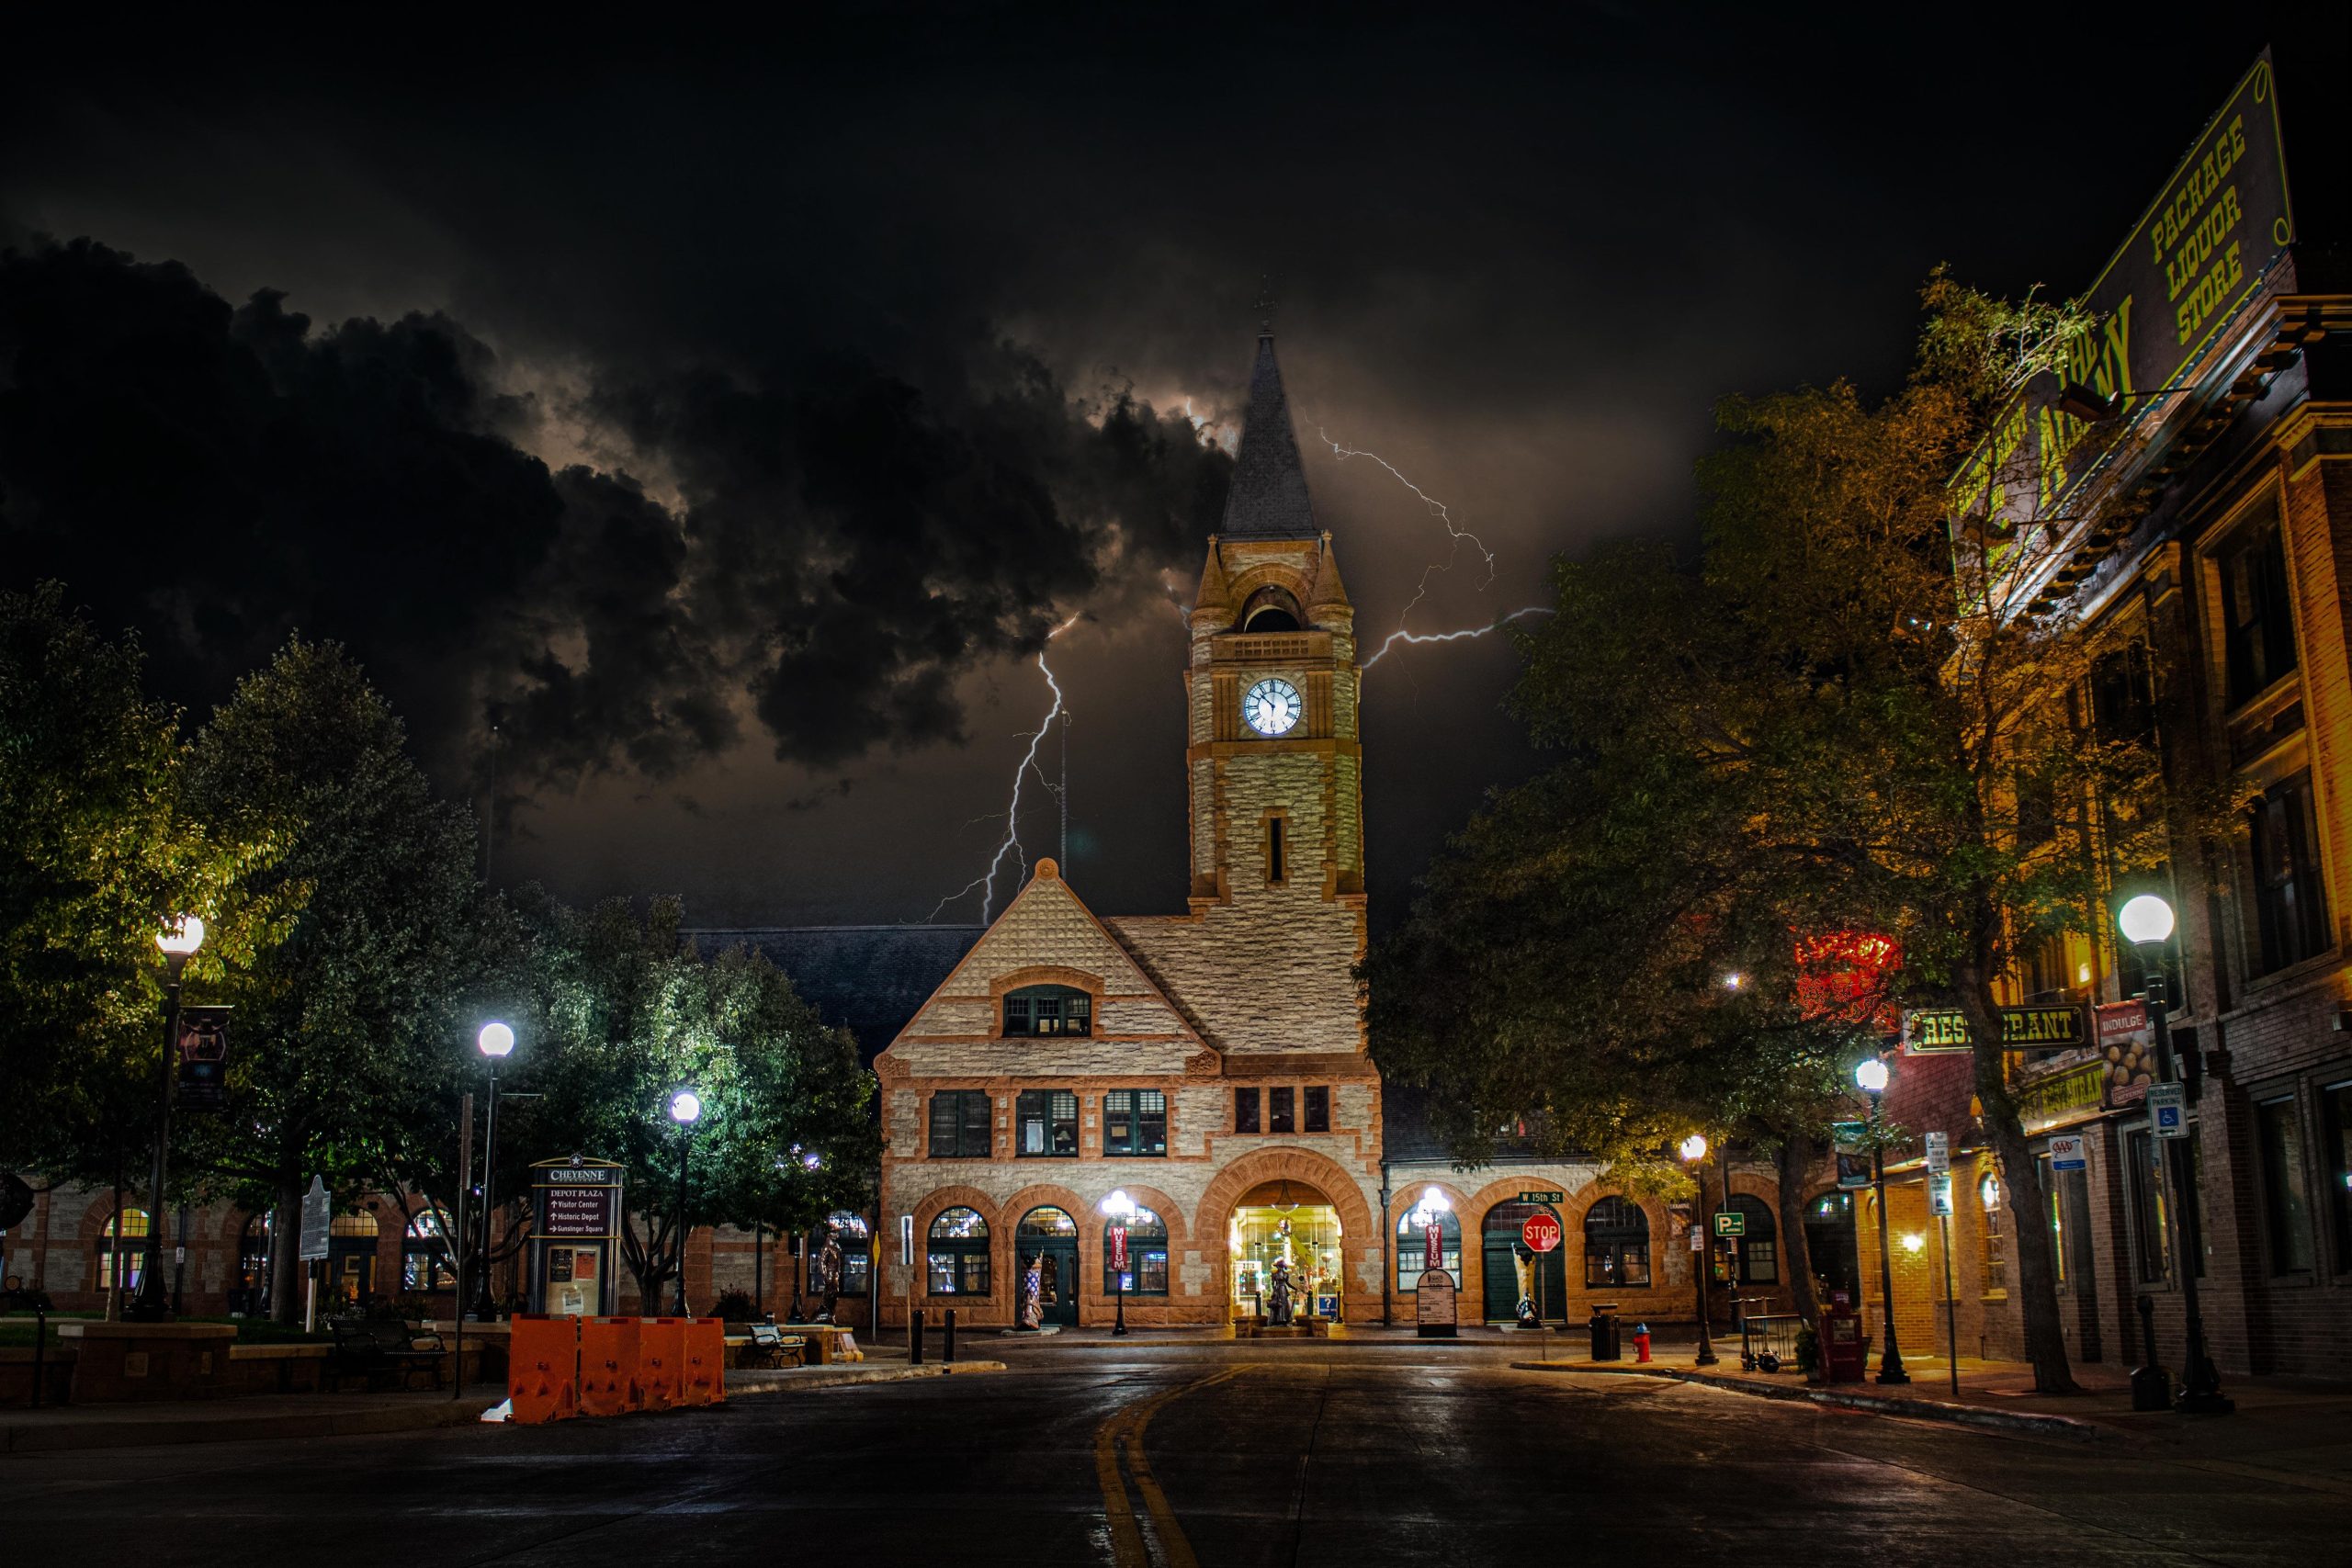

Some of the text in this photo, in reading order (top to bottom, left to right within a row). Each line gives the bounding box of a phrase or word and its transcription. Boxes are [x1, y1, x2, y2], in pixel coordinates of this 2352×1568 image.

[2150, 113, 2246, 265] PACKAGE
[2165, 184, 2242, 302] LIQUOR
[2176, 239, 2243, 346] STORE
[2102, 1015, 2143, 1032] INDULGE
[2151, 1088, 2182, 1097] RESERVED
[2153, 1097, 2181, 1106] PARKING
[550, 1170, 605, 1180] CHEYENNE
[1521, 1192, 1560, 1202] W 15th St
[558, 1213, 599, 1222] Historic Depot
[558, 1225, 604, 1234] Gunslinger Square
[1525, 1225, 1558, 1240] STOP
[1114, 1227, 1125, 1270] MUSEUM
[1428, 1226, 1441, 1267] MUSEUM
